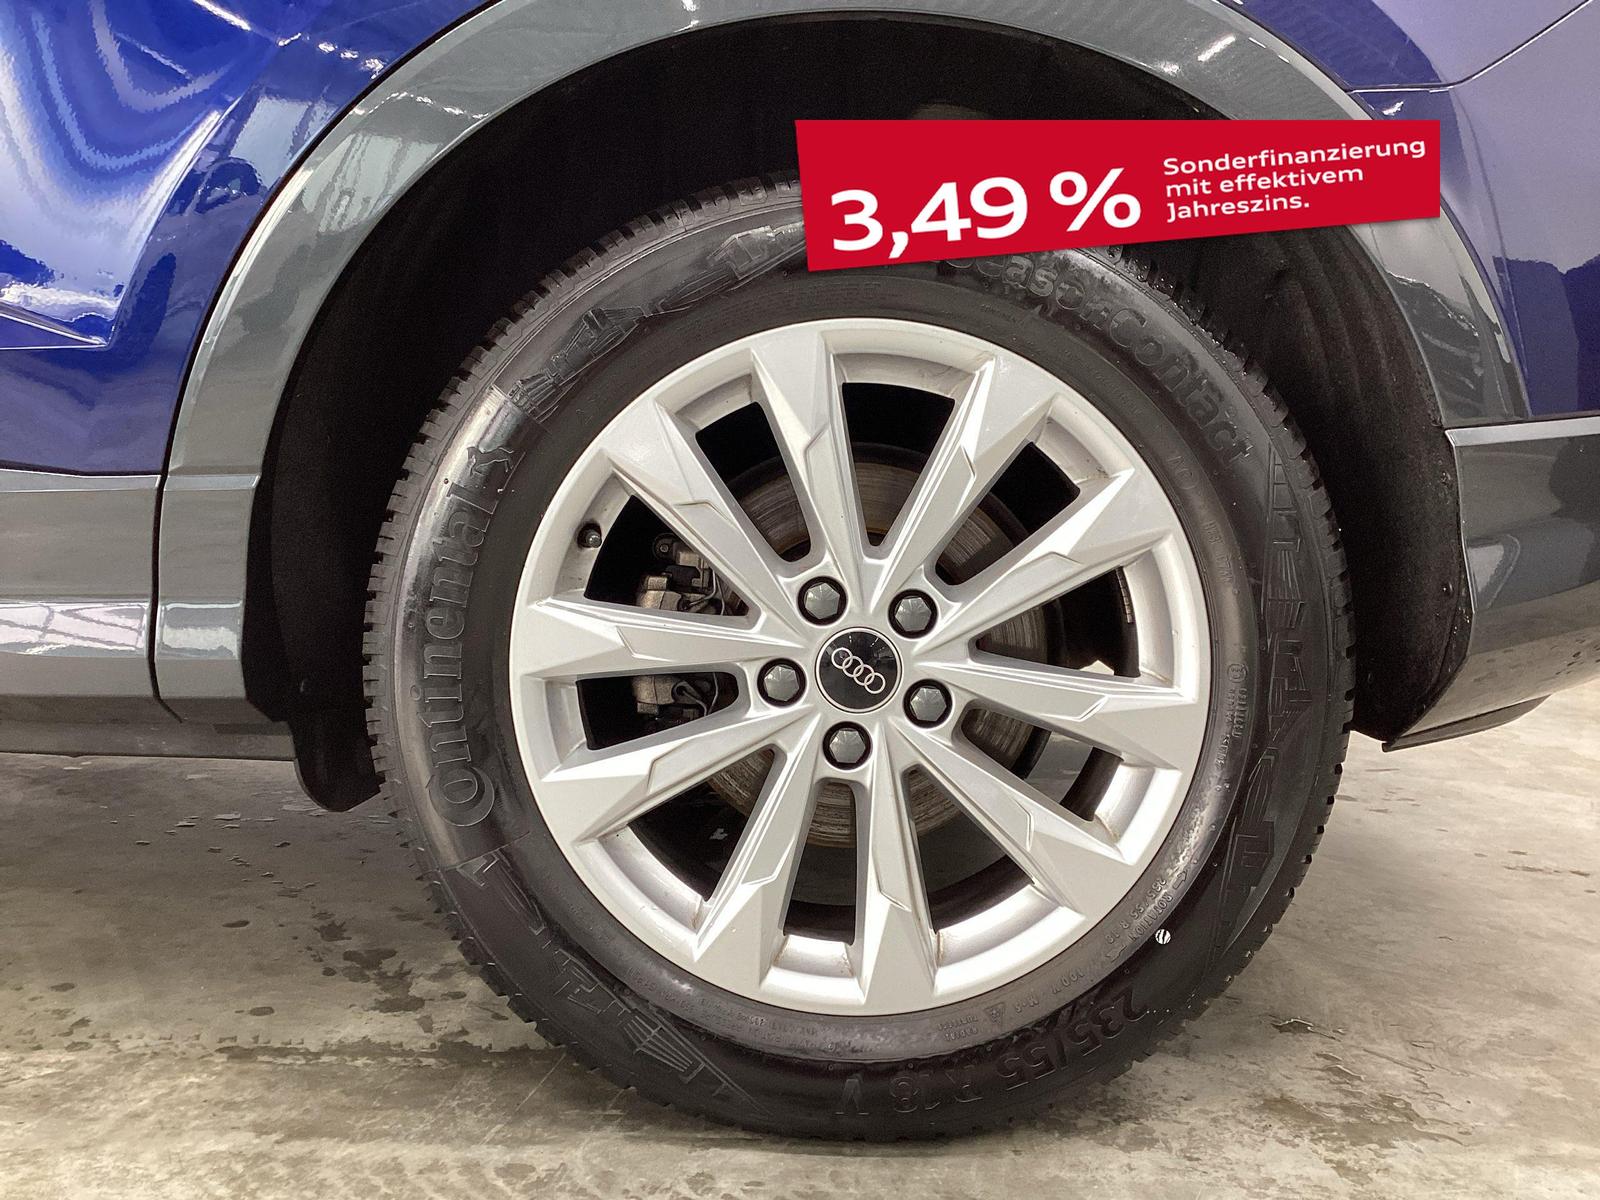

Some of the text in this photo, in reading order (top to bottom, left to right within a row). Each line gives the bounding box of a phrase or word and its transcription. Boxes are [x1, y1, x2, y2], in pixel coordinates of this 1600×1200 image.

[418, 482, 499, 827] Continental
[1127, 889, 1174, 942] ROTATION
[997, 984, 1152, 1092] 235/55
